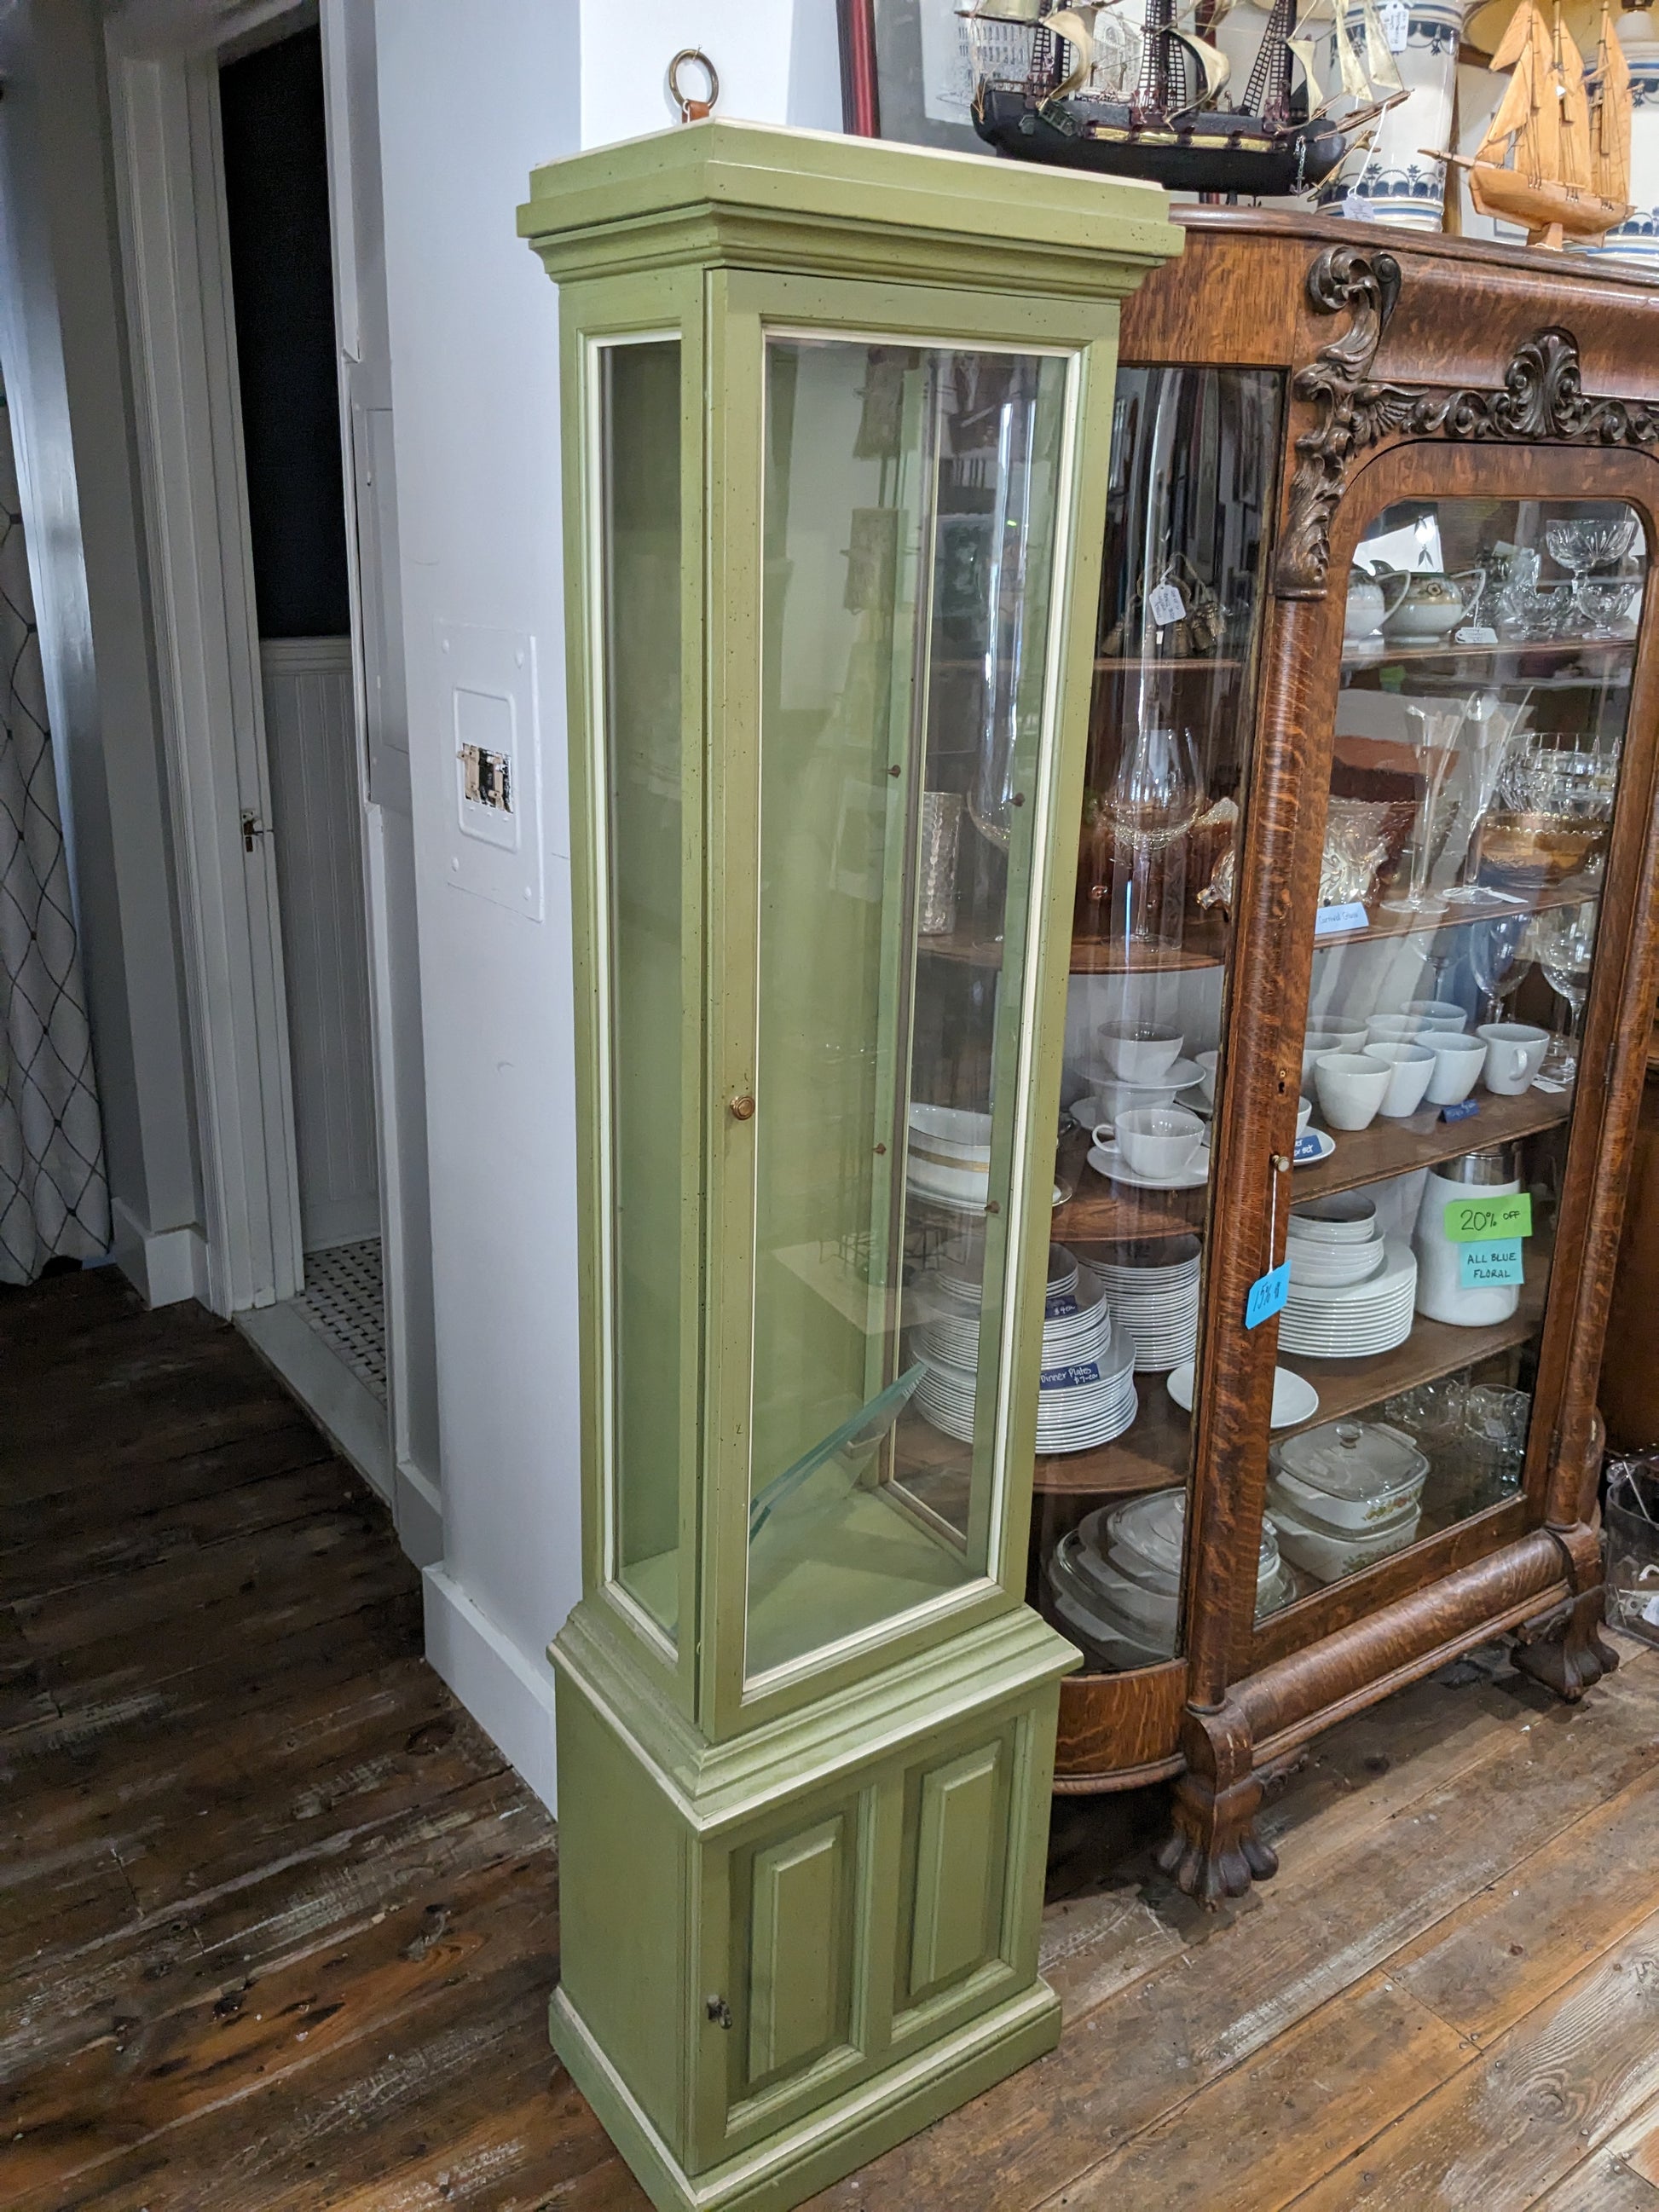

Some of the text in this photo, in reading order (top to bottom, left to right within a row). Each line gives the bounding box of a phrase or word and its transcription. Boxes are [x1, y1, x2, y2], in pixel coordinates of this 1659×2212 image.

[1460, 1209, 1520, 1231] 20% OFF
[1467, 1252, 1517, 1265] ALL BLUE
[1473, 1269, 1511, 1279] FLORAL
[1040, 1366, 1092, 1383] Dinner Plates
